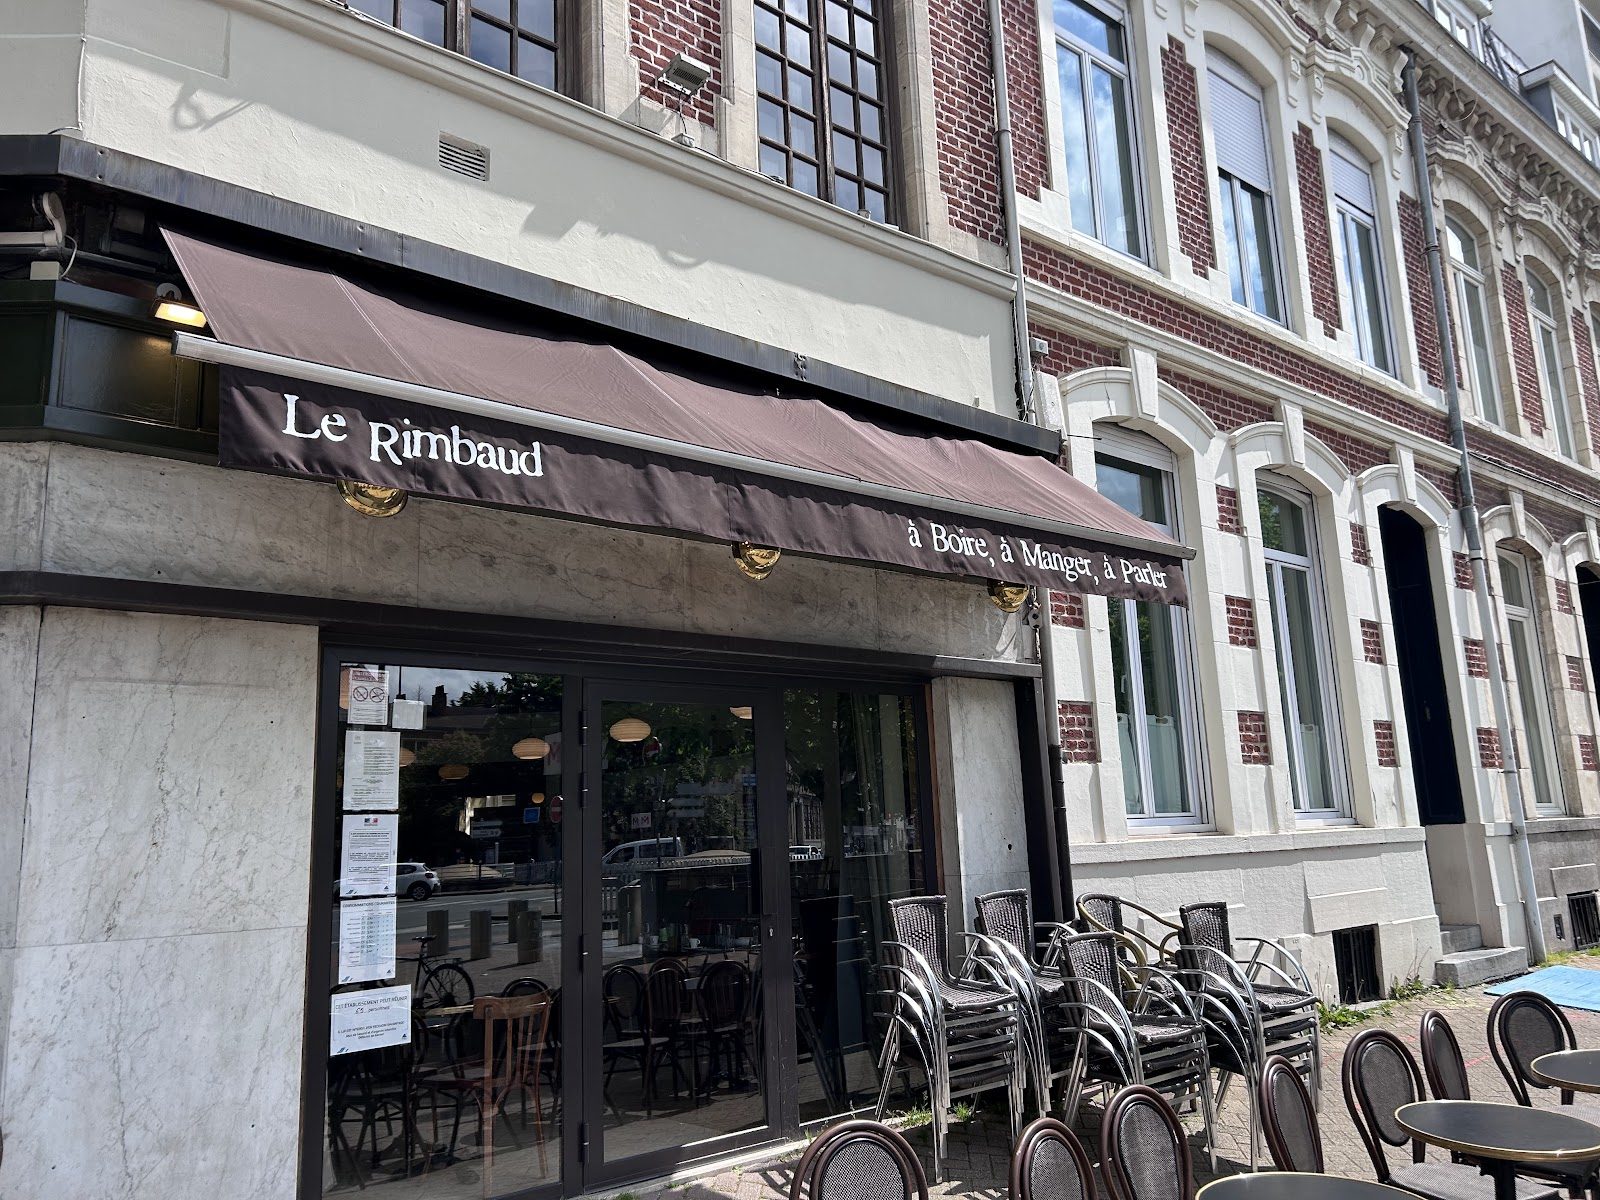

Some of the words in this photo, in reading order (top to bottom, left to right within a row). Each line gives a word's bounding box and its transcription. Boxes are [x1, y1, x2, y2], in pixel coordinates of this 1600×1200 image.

[282, 393, 347, 442] Le
[368, 418, 544, 477] Rimbaud
[908, 519, 922, 548] à
[930, 522, 996, 568] Boire,
[1000, 536, 1013, 564] à
[1020, 540, 1099, 585] Manger,
[1103, 555, 1117, 580] à
[1120, 559, 1168, 589] Parler
